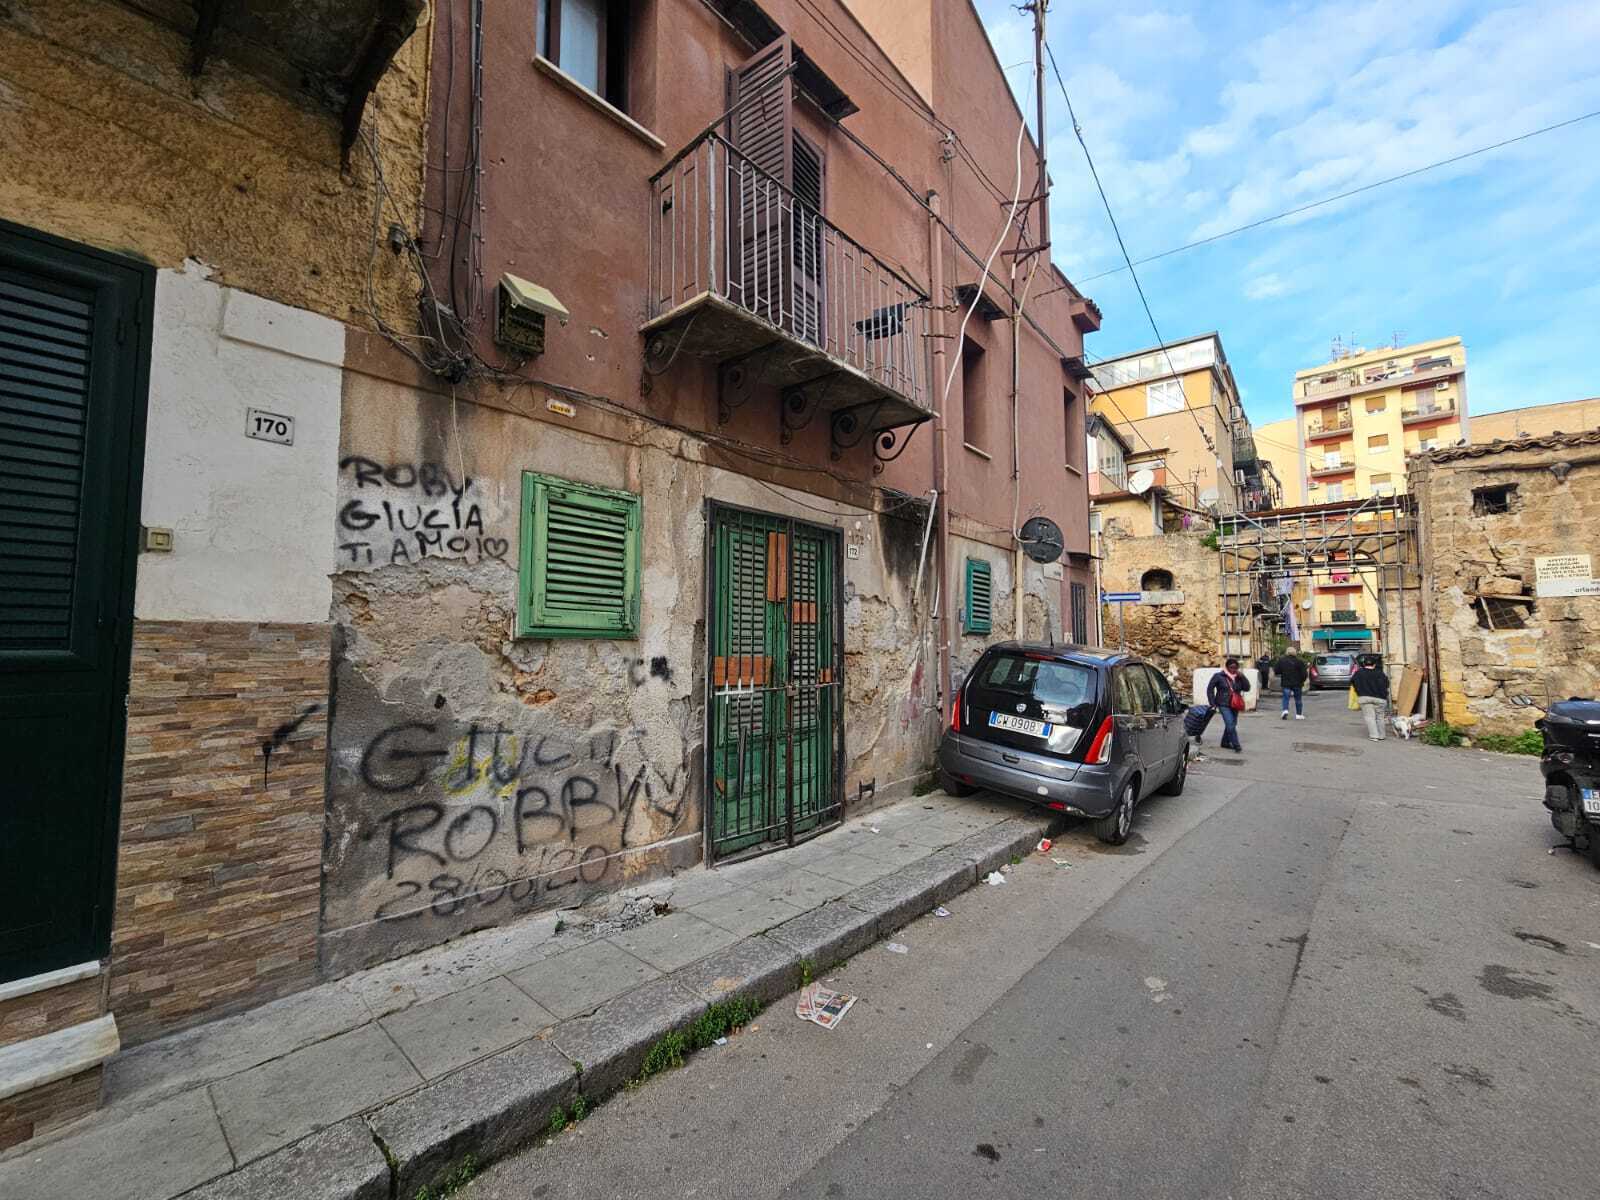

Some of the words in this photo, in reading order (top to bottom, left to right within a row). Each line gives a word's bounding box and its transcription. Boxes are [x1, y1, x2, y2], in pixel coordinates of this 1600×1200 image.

[254, 416, 287, 436] 170
[339, 455, 472, 498] ROBY
[339, 542, 373, 563] TI
